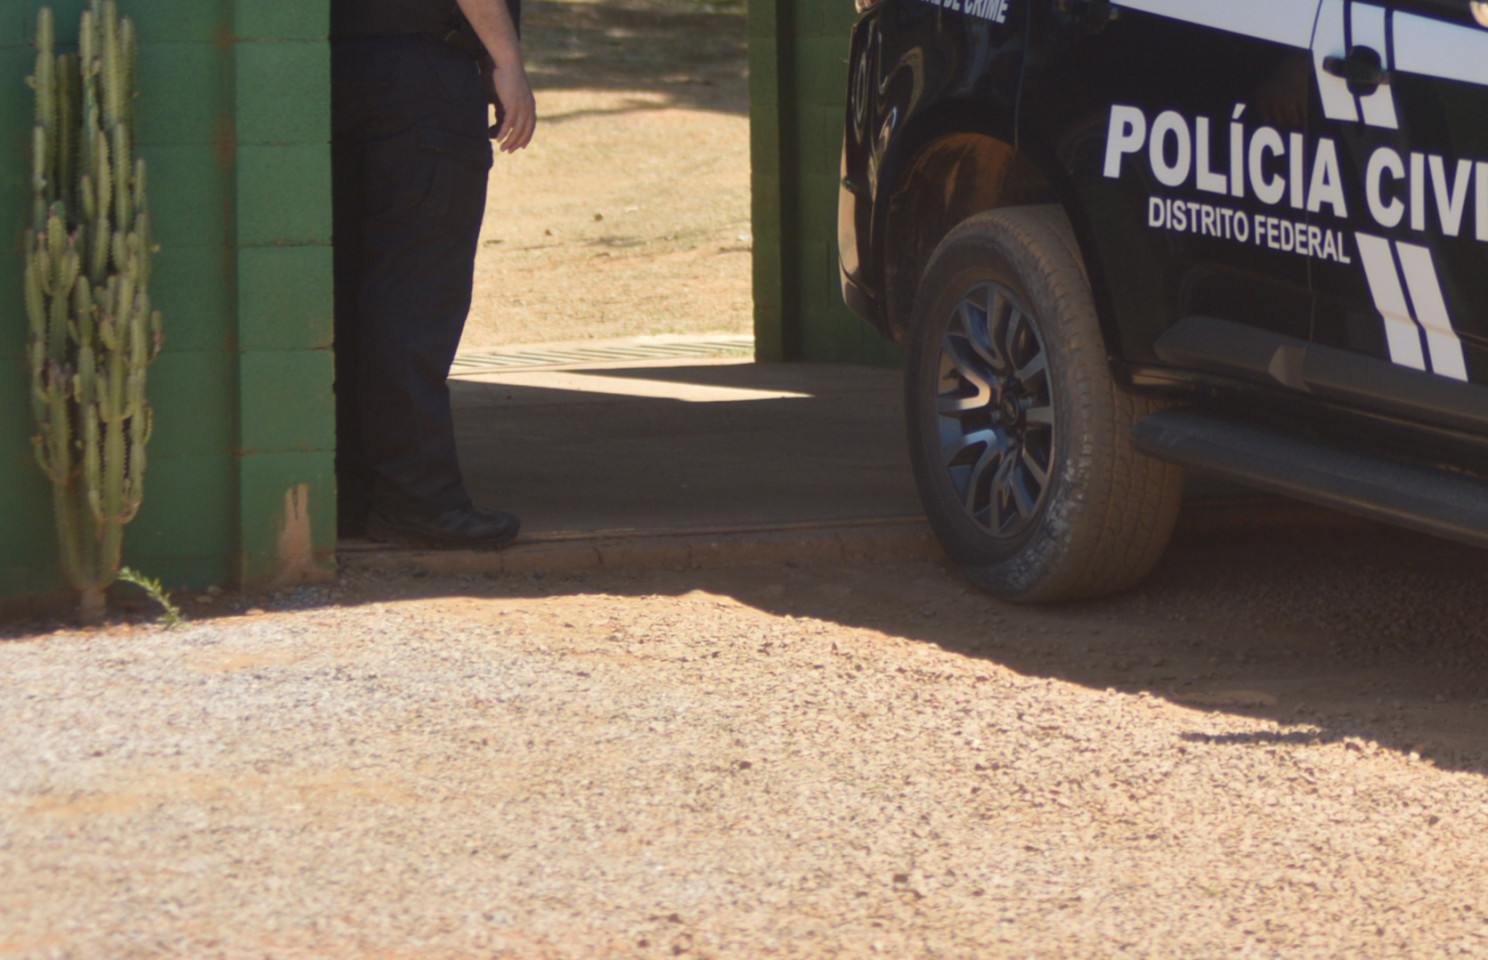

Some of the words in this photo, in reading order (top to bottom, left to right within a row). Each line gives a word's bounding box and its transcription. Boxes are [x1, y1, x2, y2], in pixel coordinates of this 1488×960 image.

[1103, 103, 1348, 218] POLÍCIA
[1148, 197, 1249, 242] DISTRITO
[1254, 214, 1351, 264] FEDERAL
